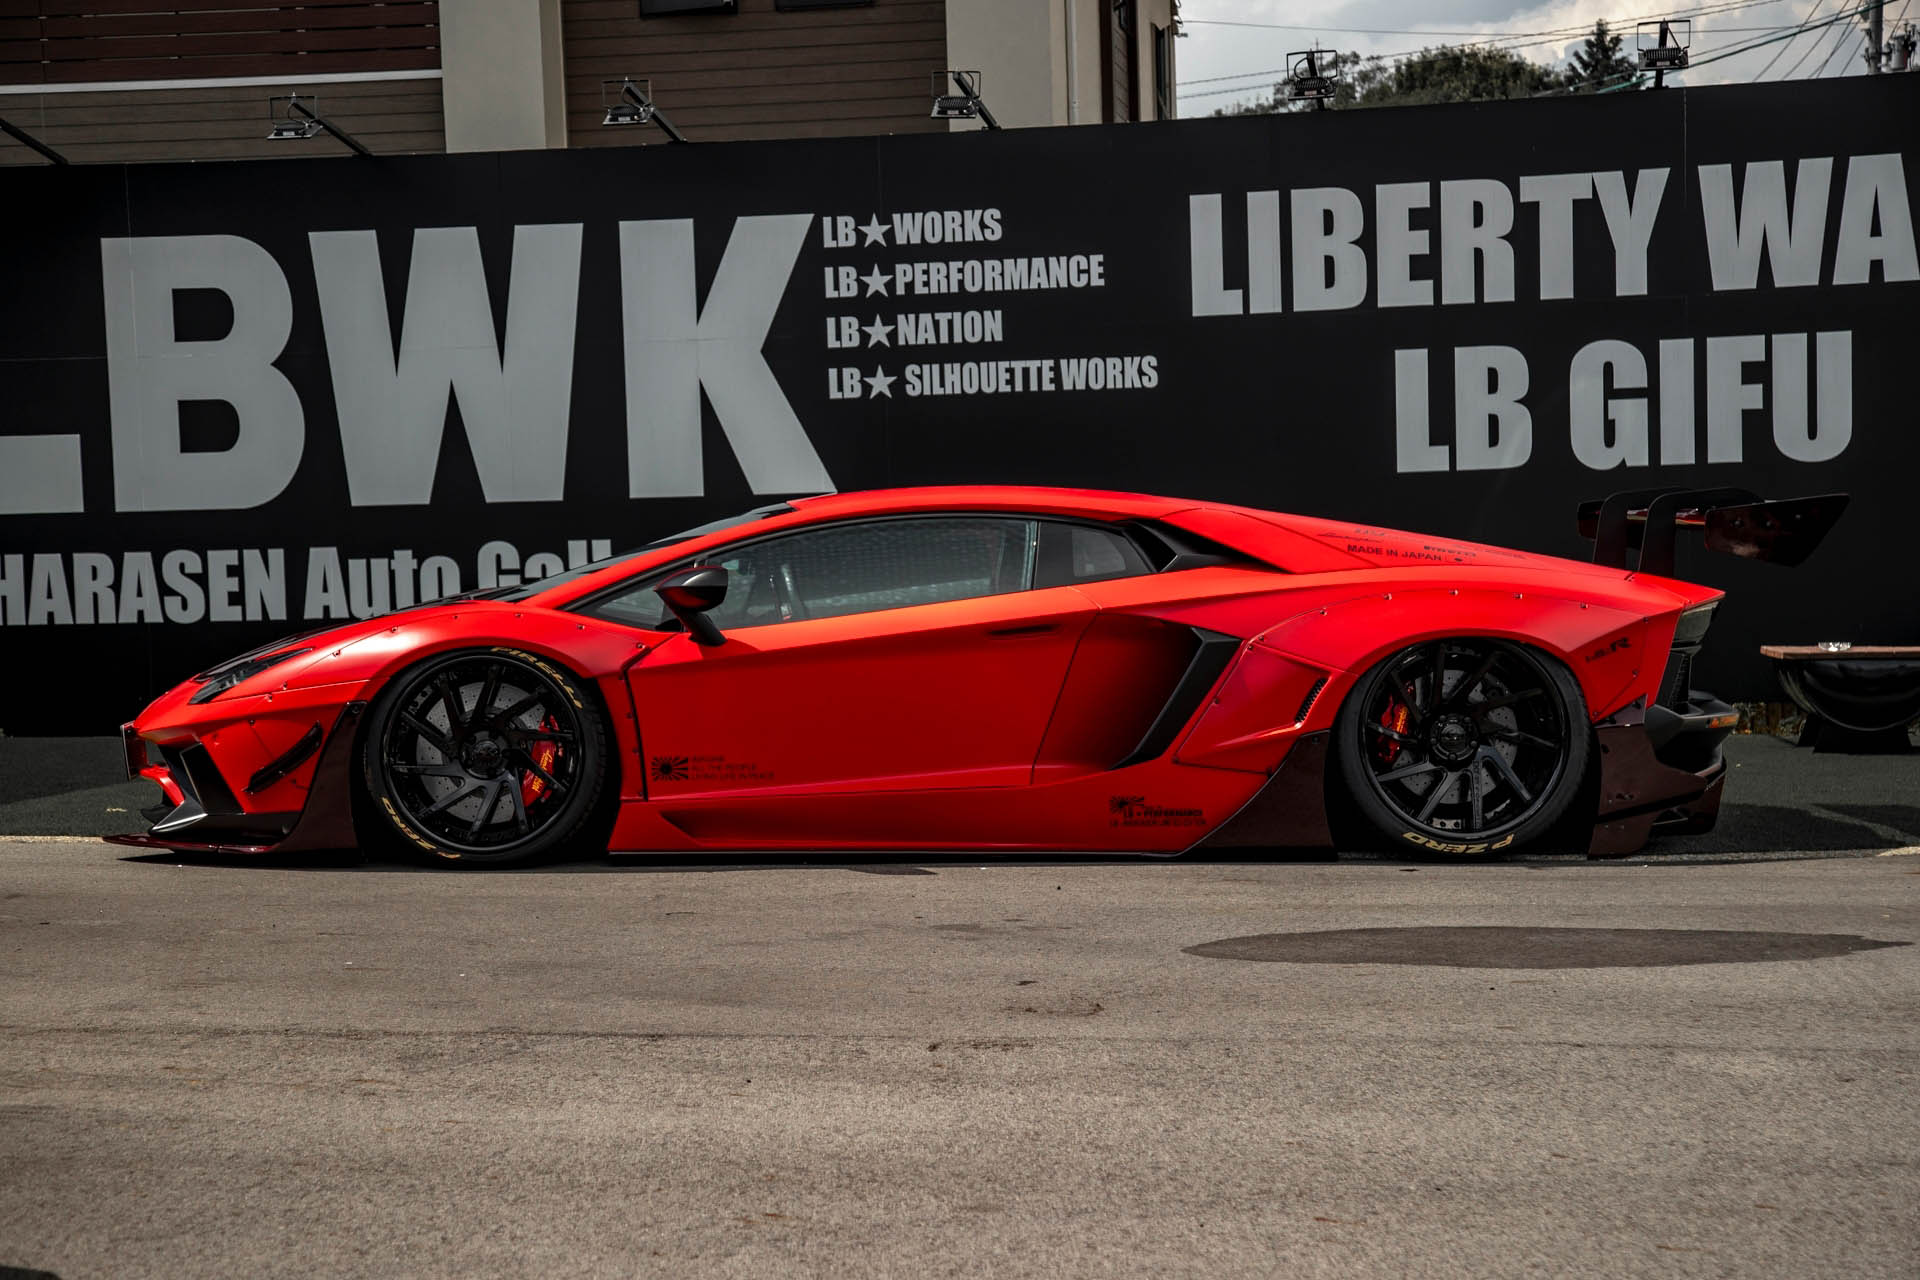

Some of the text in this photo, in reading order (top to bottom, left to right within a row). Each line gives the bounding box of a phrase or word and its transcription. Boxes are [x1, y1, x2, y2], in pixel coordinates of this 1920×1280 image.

[1190, 153, 1920, 318] LIBERTY WA
[0, 213, 836, 514] BWK
[905, 359, 1056, 397] SILHOUETTE
[1060, 355, 1159, 392] WORKS
[1395, 331, 1854, 475] LB GIFU
[0, 547, 288, 626] HARASEN
[303, 546, 462, 621] Auto
[1347, 543, 1383, 556] MADE
[1386, 548, 1399, 558] IN
[1402, 550, 1442, 562] JAPAN
[490, 646, 583, 709] PIRELLI
[1402, 831, 1516, 854] P ZERO
